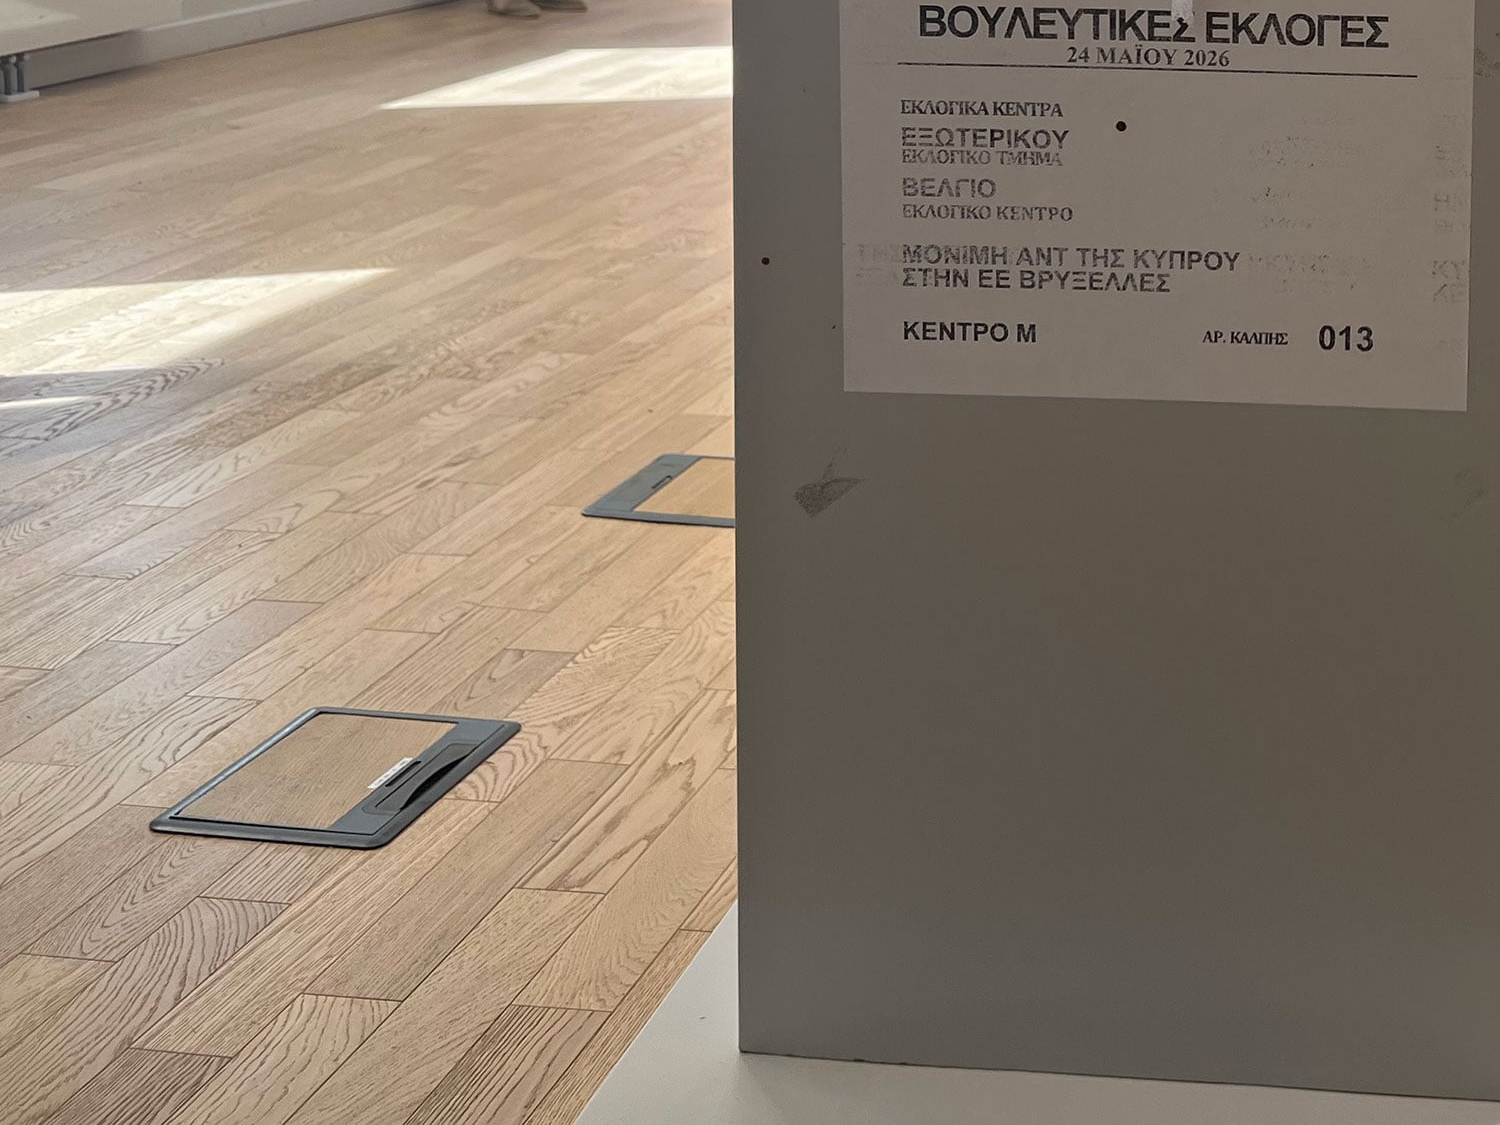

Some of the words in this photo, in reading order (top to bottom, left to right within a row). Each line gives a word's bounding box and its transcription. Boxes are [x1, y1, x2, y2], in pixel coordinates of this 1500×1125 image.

[919, 4, 1196, 43] ΒΟΥΛΕΥΤΙΚΕΣ
[1206, 11, 1390, 48] ΕΚΛΟΓΕΣ
[1066, 46, 1091, 64] 24
[1096, 45, 1178, 67] ΜΑΪΟΥ
[1184, 49, 1231, 68] 2026
[900, 99, 989, 116] ΕΚΛΟΓΙΚΑ
[992, 101, 1064, 117] ΚΕΝΤΡΑ
[901, 127, 1071, 149] ΕΞΩΤΕΡΙΚΟΥ
[902, 149, 991, 164] ΕΚΛΟΓΙΚΟ
[996, 151, 1063, 166] ΤΜΗΜΑ
[902, 177, 996, 198] ΒΕΛΓΙΟ
[903, 204, 991, 220] ΕΚΛΟΓΙΚΟ
[996, 206, 1073, 221] ΚΕΝΤΡΟ
[901, 244, 1008, 265] ΜΟΝΙΜΗ
[1016, 247, 1069, 266] ΑΝΤ
[1076, 248, 1125, 268] ΤΗΣ
[1133, 249, 1240, 271] ΚΥΠΡΟΥ
[902, 267, 969, 288] ΣΤΗΝ
[979, 269, 1011, 289] ΕΕ
[1020, 270, 1170, 293] ΒΡΥΞΕΛΛΕΣ
[904, 321, 1008, 342] ΚΕΝΤΡΟ
[1202, 330, 1226, 344] ΑΡ.
[1230, 331, 1288, 345] ΚΑΛΠΗΣ
[1319, 325, 1373, 352] 013
